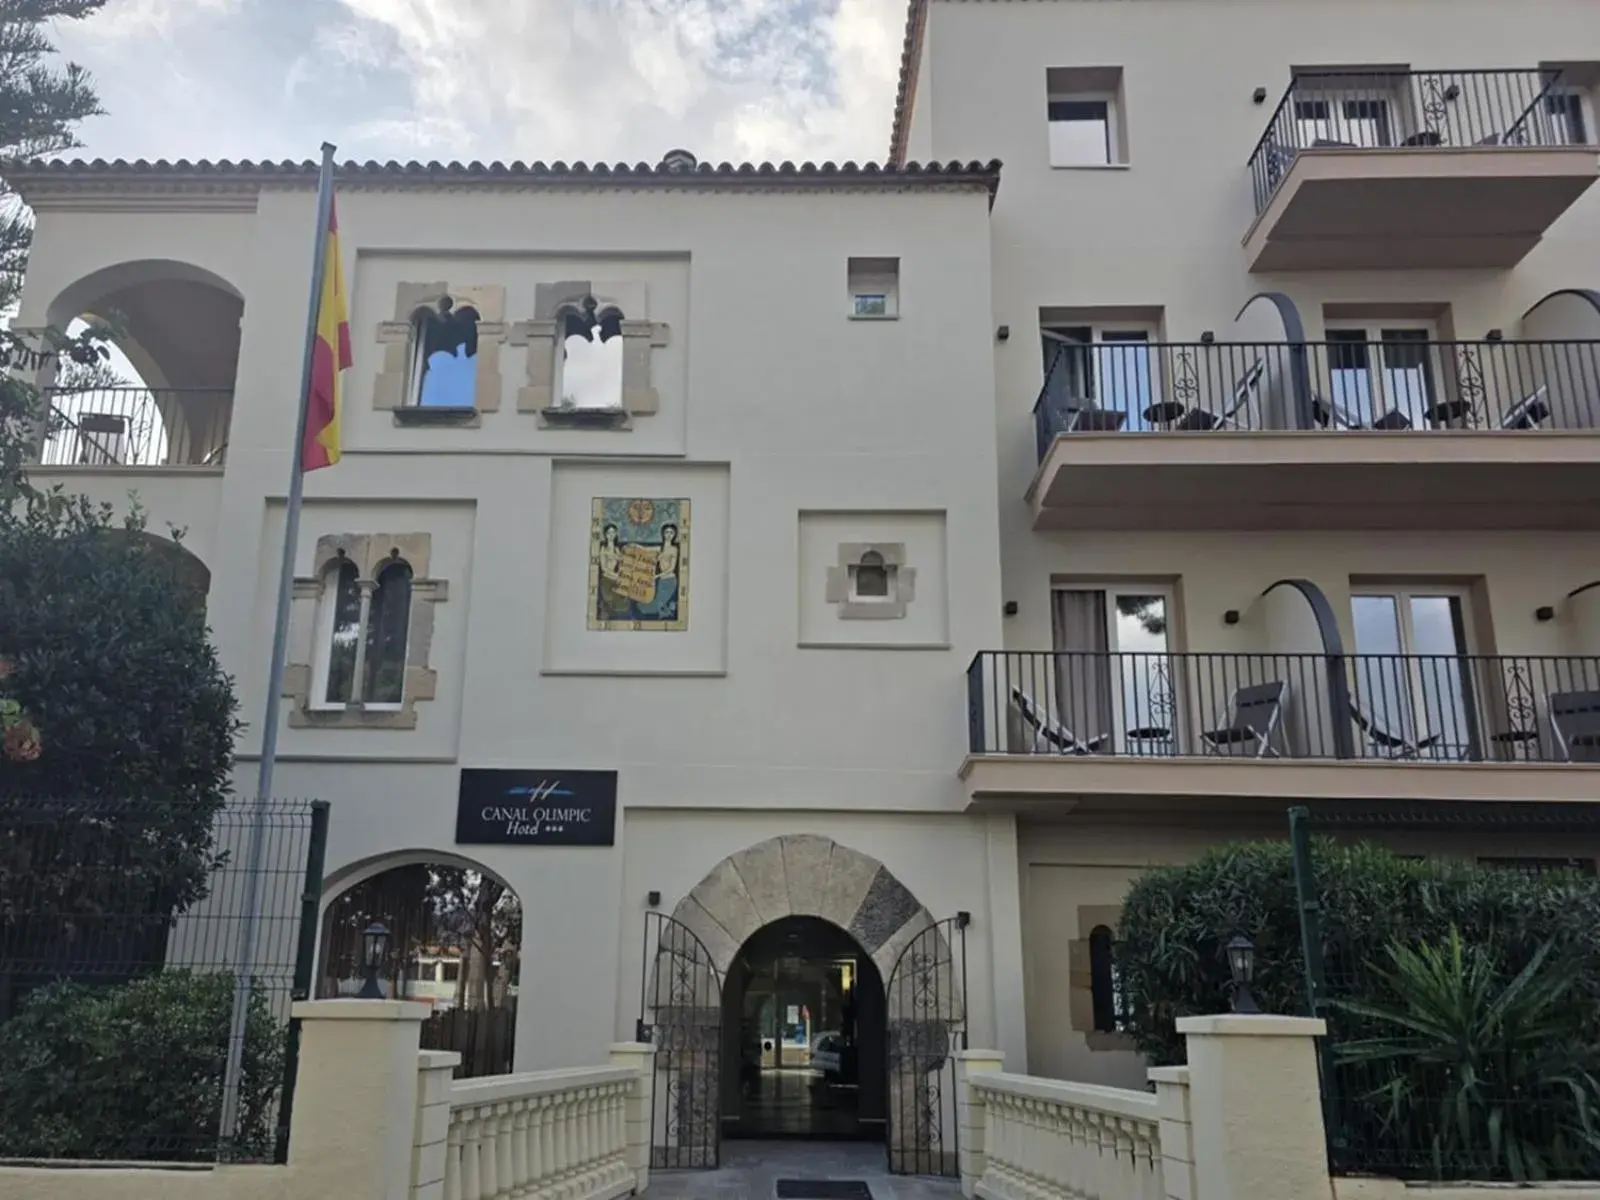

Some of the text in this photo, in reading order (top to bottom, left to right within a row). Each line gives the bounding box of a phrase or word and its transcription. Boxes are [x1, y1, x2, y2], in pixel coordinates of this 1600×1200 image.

[481, 806, 591, 822] CANAL OLIMPIC
[506, 821, 540, 835] Hotel
